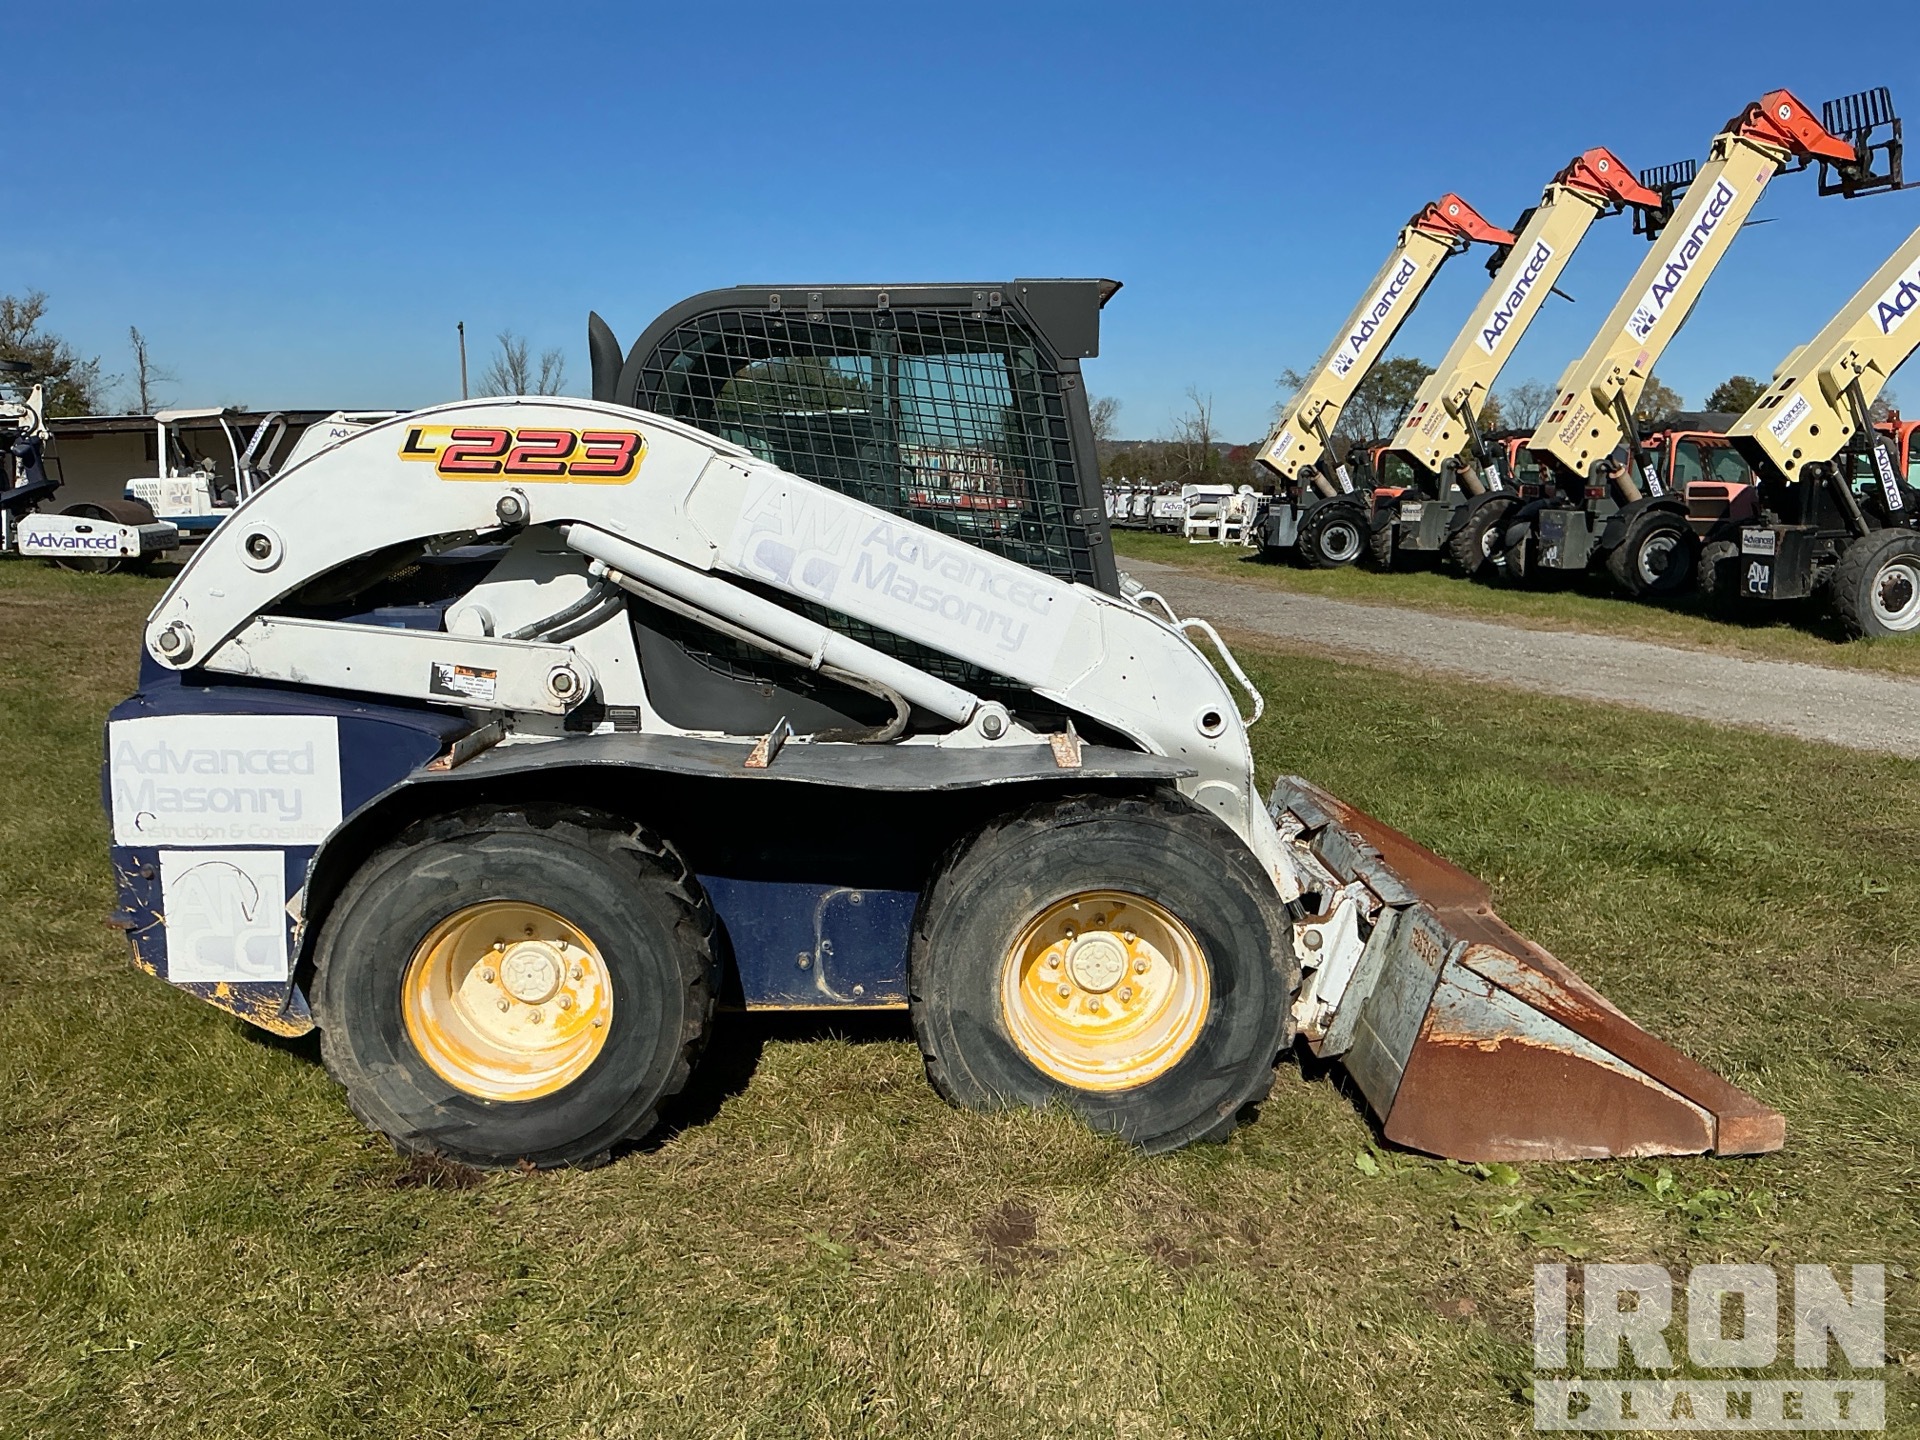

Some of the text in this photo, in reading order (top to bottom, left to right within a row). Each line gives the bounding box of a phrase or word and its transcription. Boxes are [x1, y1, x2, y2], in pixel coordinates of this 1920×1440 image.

[1780, 106, 1790, 118] 12
[1651, 181, 1733, 309] Advanced
[1350, 258, 1417, 354] Advanced
[1482, 242, 1550, 350] Advanced
[1559, 404, 1585, 441] Advanced
[1563, 413, 1589, 445] Masonry
[1772, 397, 1805, 434] Advanced
[403, 428, 643, 477] L223
[1876, 448, 1902, 509] Advanced
[26, 533, 117, 549] Advanced
[1744, 535, 1773, 545] Advanced
[861, 520, 1058, 616] Advanced
[851, 551, 1028, 652] Masonry
[114, 740, 315, 775] Advanced
[117, 778, 303, 822] Masonry
